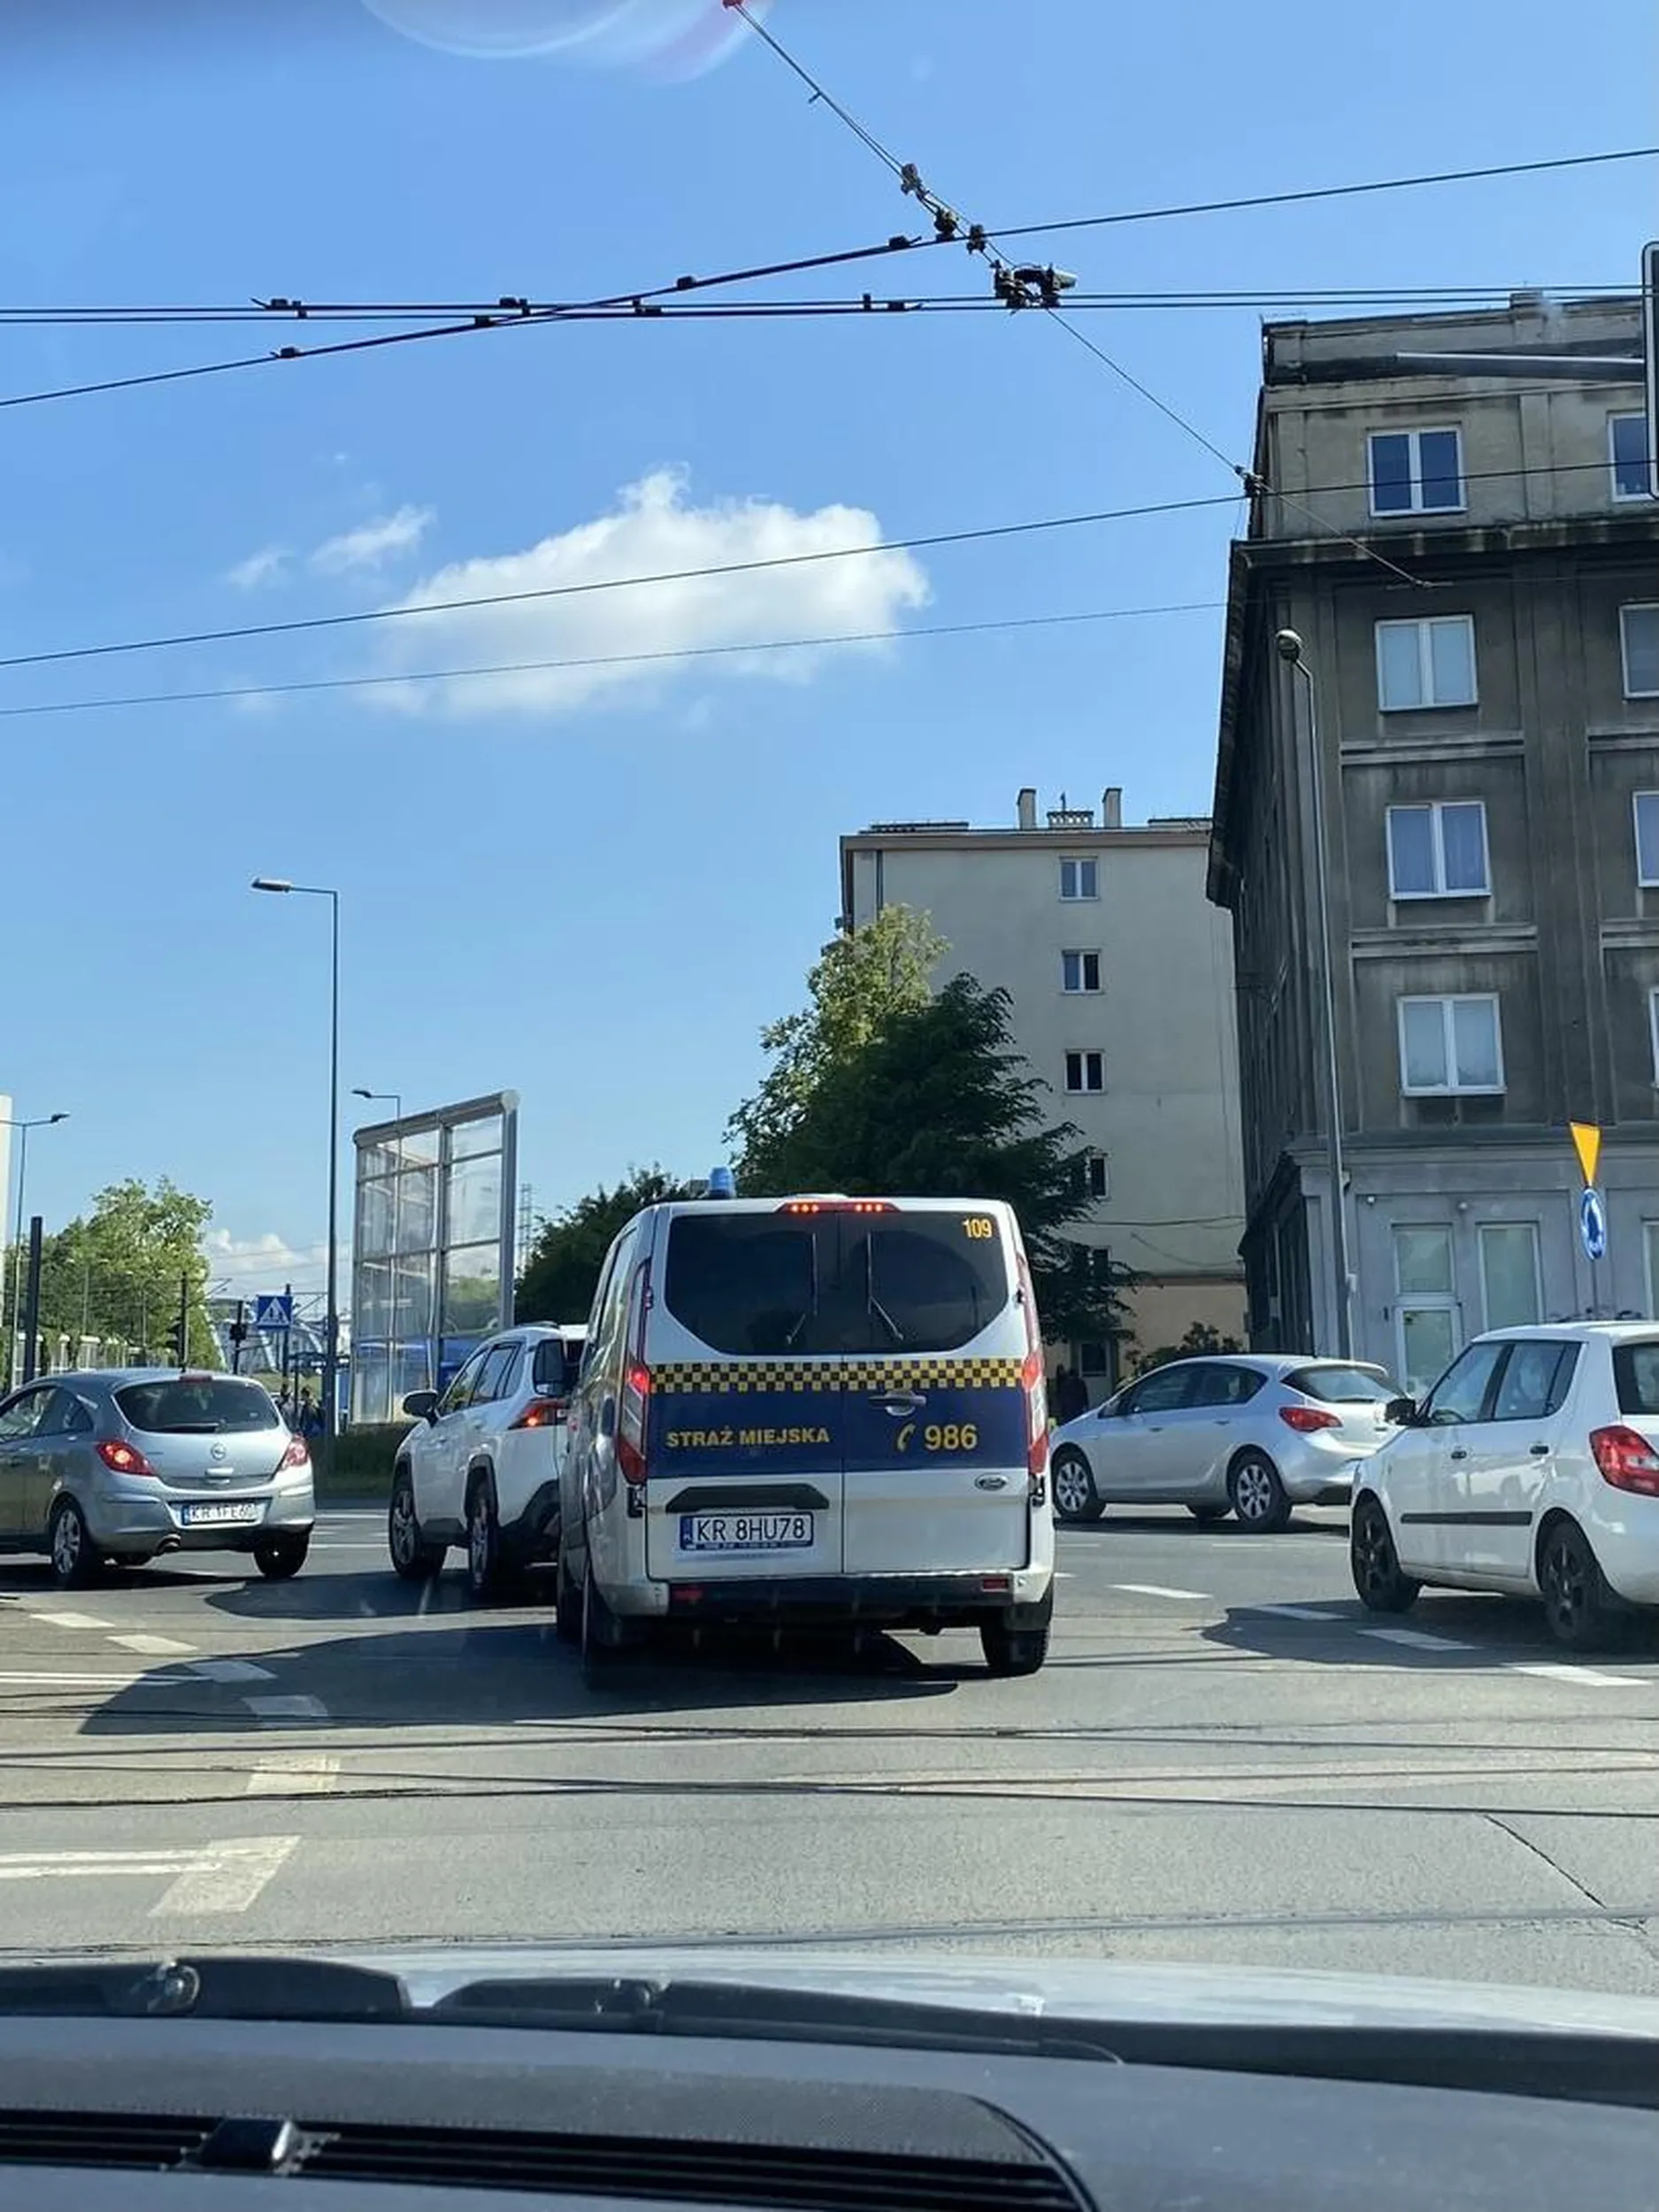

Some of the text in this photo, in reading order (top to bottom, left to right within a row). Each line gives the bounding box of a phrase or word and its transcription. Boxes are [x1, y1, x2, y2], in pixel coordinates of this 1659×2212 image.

[962, 1218, 992, 1238] 109
[665, 1425, 829, 1447] STRAŻ MIEJSKA
[925, 1424, 977, 1449] 986
[697, 1517, 805, 1540] KR 8HU78
